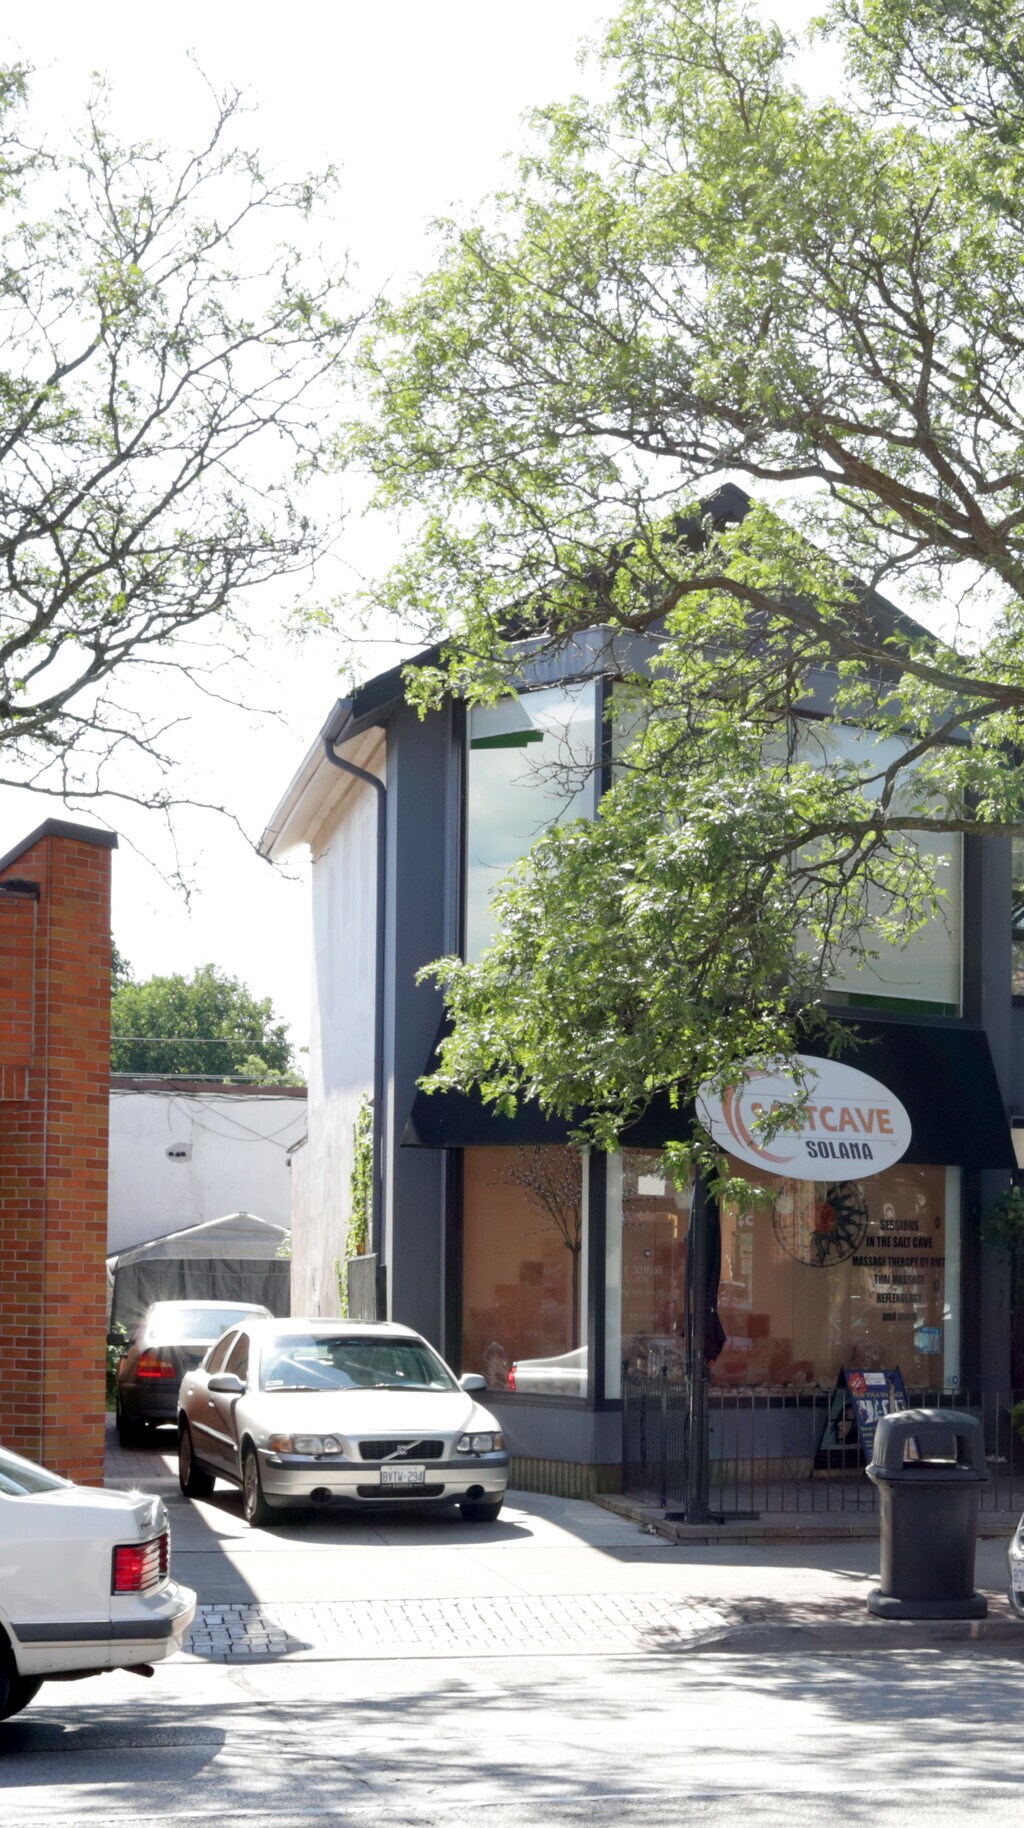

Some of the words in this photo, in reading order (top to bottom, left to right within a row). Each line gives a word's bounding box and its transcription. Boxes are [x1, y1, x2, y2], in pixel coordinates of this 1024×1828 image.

[805, 1140, 874, 1160] SOLANA
[880, 1220, 919, 1231] SESSIONS
[866, 1236, 875, 1247] IN
[876, 1236, 892, 1247] THE
[893, 1236, 911, 1248] SALT
[912, 1237, 933, 1248] CAVE
[852, 1256, 886, 1267] MASSAGE
[888, 1256, 918, 1267] THERAPY
